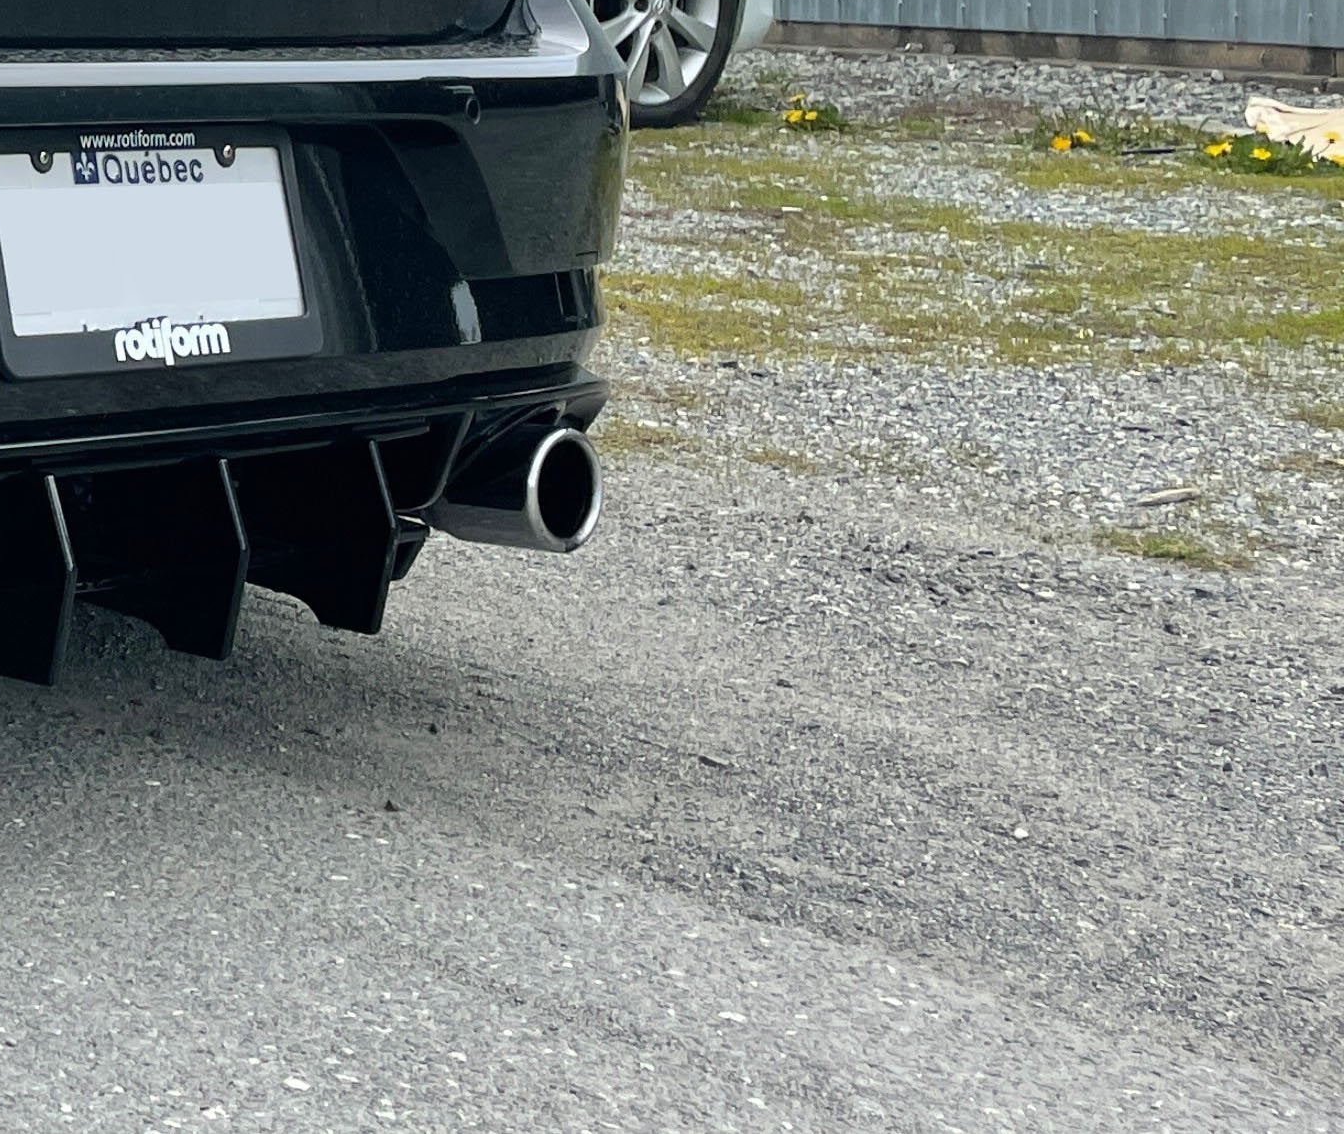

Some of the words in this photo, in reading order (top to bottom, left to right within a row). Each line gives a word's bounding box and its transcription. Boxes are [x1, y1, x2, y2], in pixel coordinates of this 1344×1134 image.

[80, 130, 195, 149] www.rotiform.com
[102, 151, 204, 184] Québec
[115, 317, 231, 366] rotiform
